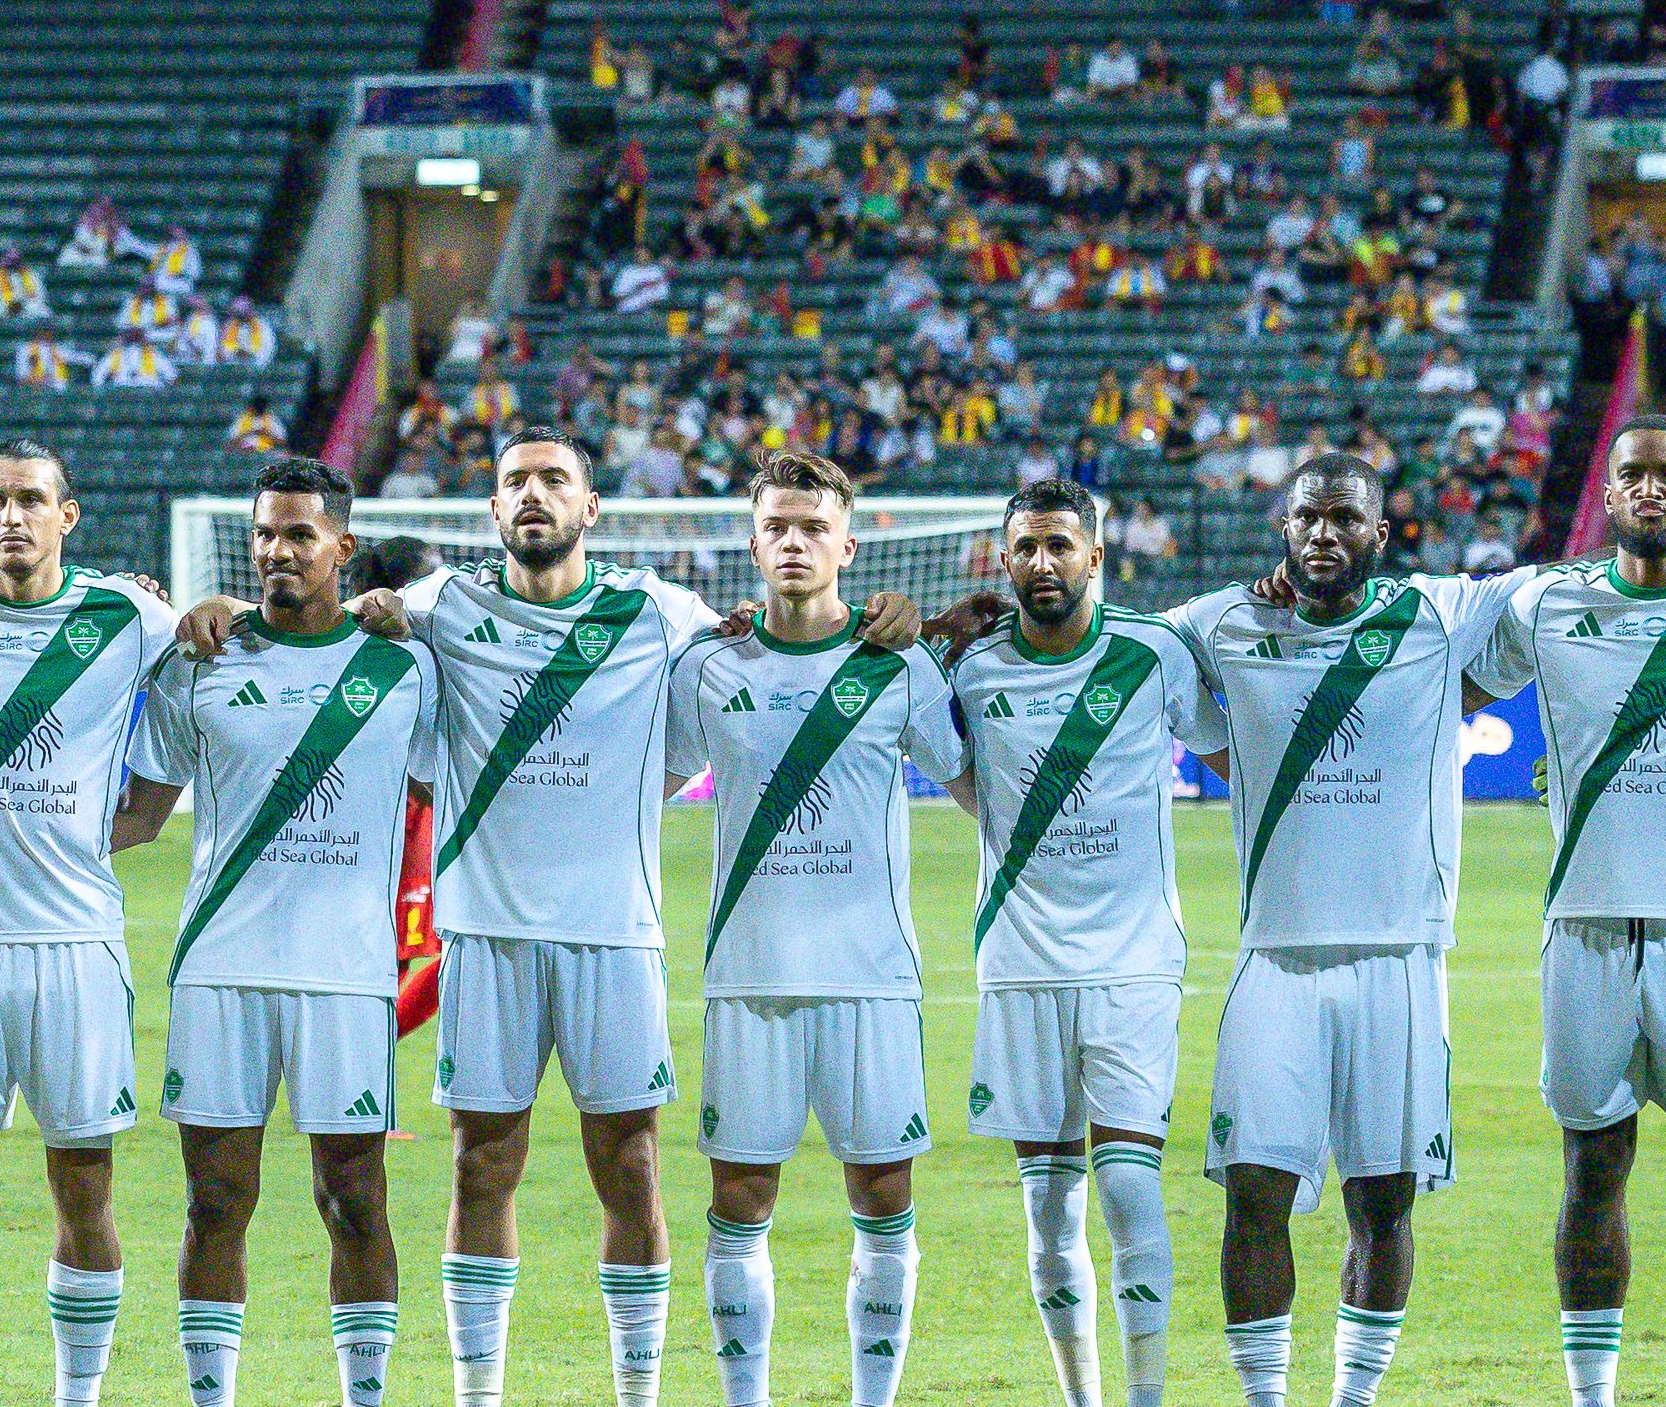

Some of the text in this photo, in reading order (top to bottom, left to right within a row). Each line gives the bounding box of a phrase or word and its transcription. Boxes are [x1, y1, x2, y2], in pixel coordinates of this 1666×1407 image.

[1614, 629, 1639, 637] SIRC
[515, 639, 539, 648] SIRC
[280, 696, 305, 705] SIRC
[768, 703, 792, 711] SIRC
[1026, 708, 1051, 717] SIRC
[509, 771, 536, 785] Sea
[540, 772, 589, 788] Global
[1625, 780, 1653, 795] Sea
[1304, 790, 1331, 804] Sea
[1334, 789, 1381, 804] Global
[28, 798, 76, 815] Global
[1037, 844, 1066, 858] Sea
[1069, 838, 1119, 856] Global
[280, 850, 306, 864] Sea
[311, 850, 358, 866] Global
[770, 862, 798, 875] Sea
[802, 860, 852, 875] Global
[863, 1302, 903, 1316] AHLI
[625, 1348, 660, 1360] AHLI
